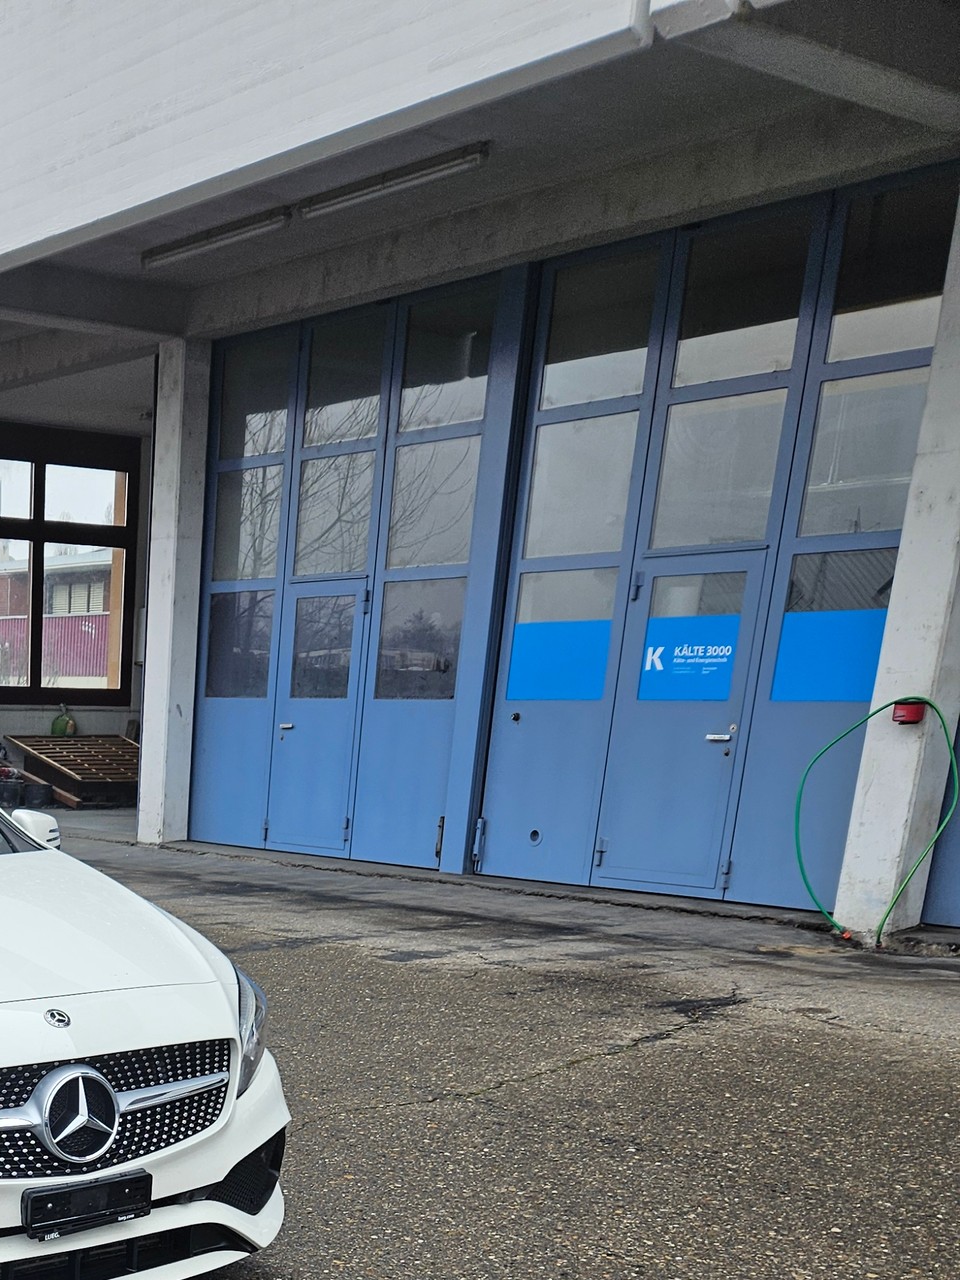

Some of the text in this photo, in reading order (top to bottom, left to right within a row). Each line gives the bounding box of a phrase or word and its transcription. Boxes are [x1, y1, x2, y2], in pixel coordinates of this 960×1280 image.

[645, 646, 665, 671] K
[674, 644, 732, 656] KÄLTE 3000
